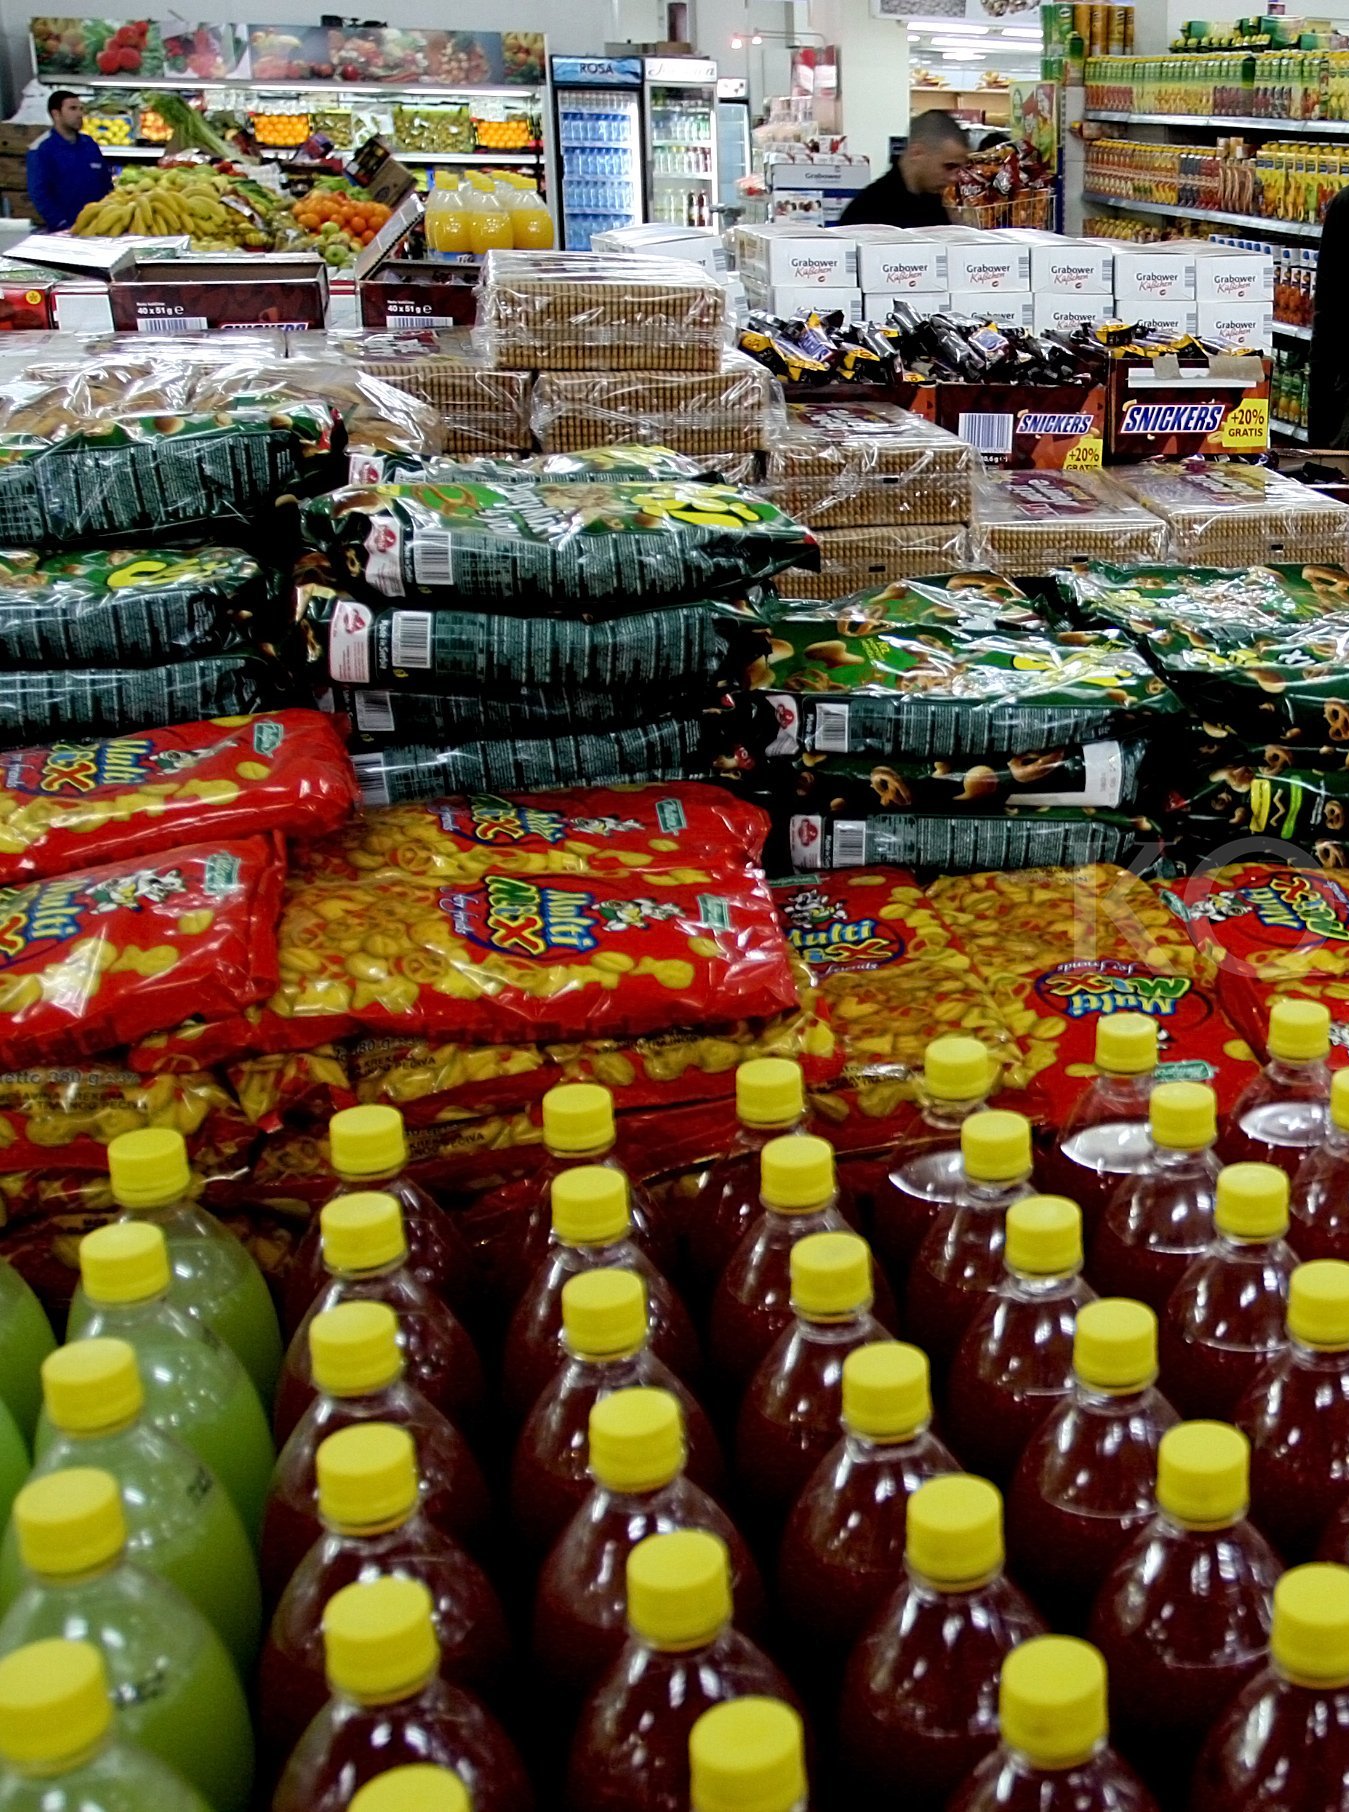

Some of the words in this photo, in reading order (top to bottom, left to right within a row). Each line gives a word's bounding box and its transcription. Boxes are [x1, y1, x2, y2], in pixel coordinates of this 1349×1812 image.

[579, 63, 614, 75] ROSA
[791, 258, 837, 268] Grabower
[882, 263, 928, 273] Grabower
[966, 264, 1011, 273] Grabower
[1051, 265, 1094, 274] Grabower
[1136, 272, 1178, 281] Grabower
[1214, 275, 1256, 284] Grabower
[137, 307, 148, 315] 40
[387, 305, 398, 313] 40
[405, 306, 415, 314] 51
[1053, 311, 1096, 321] Grabower
[1216, 321, 1256, 330] Grabower
[1122, 404, 1224, 433] SNICKERS
[1230, 409, 1265, 425] +20%
[1019, 413, 1092, 433] SNICKERS
[1228, 428, 1264, 438] GRATIS
[1068, 447, 1100, 463] +20%
[546, 889, 598, 950] Multi
[1070, 992, 1176, 1017] Multi
